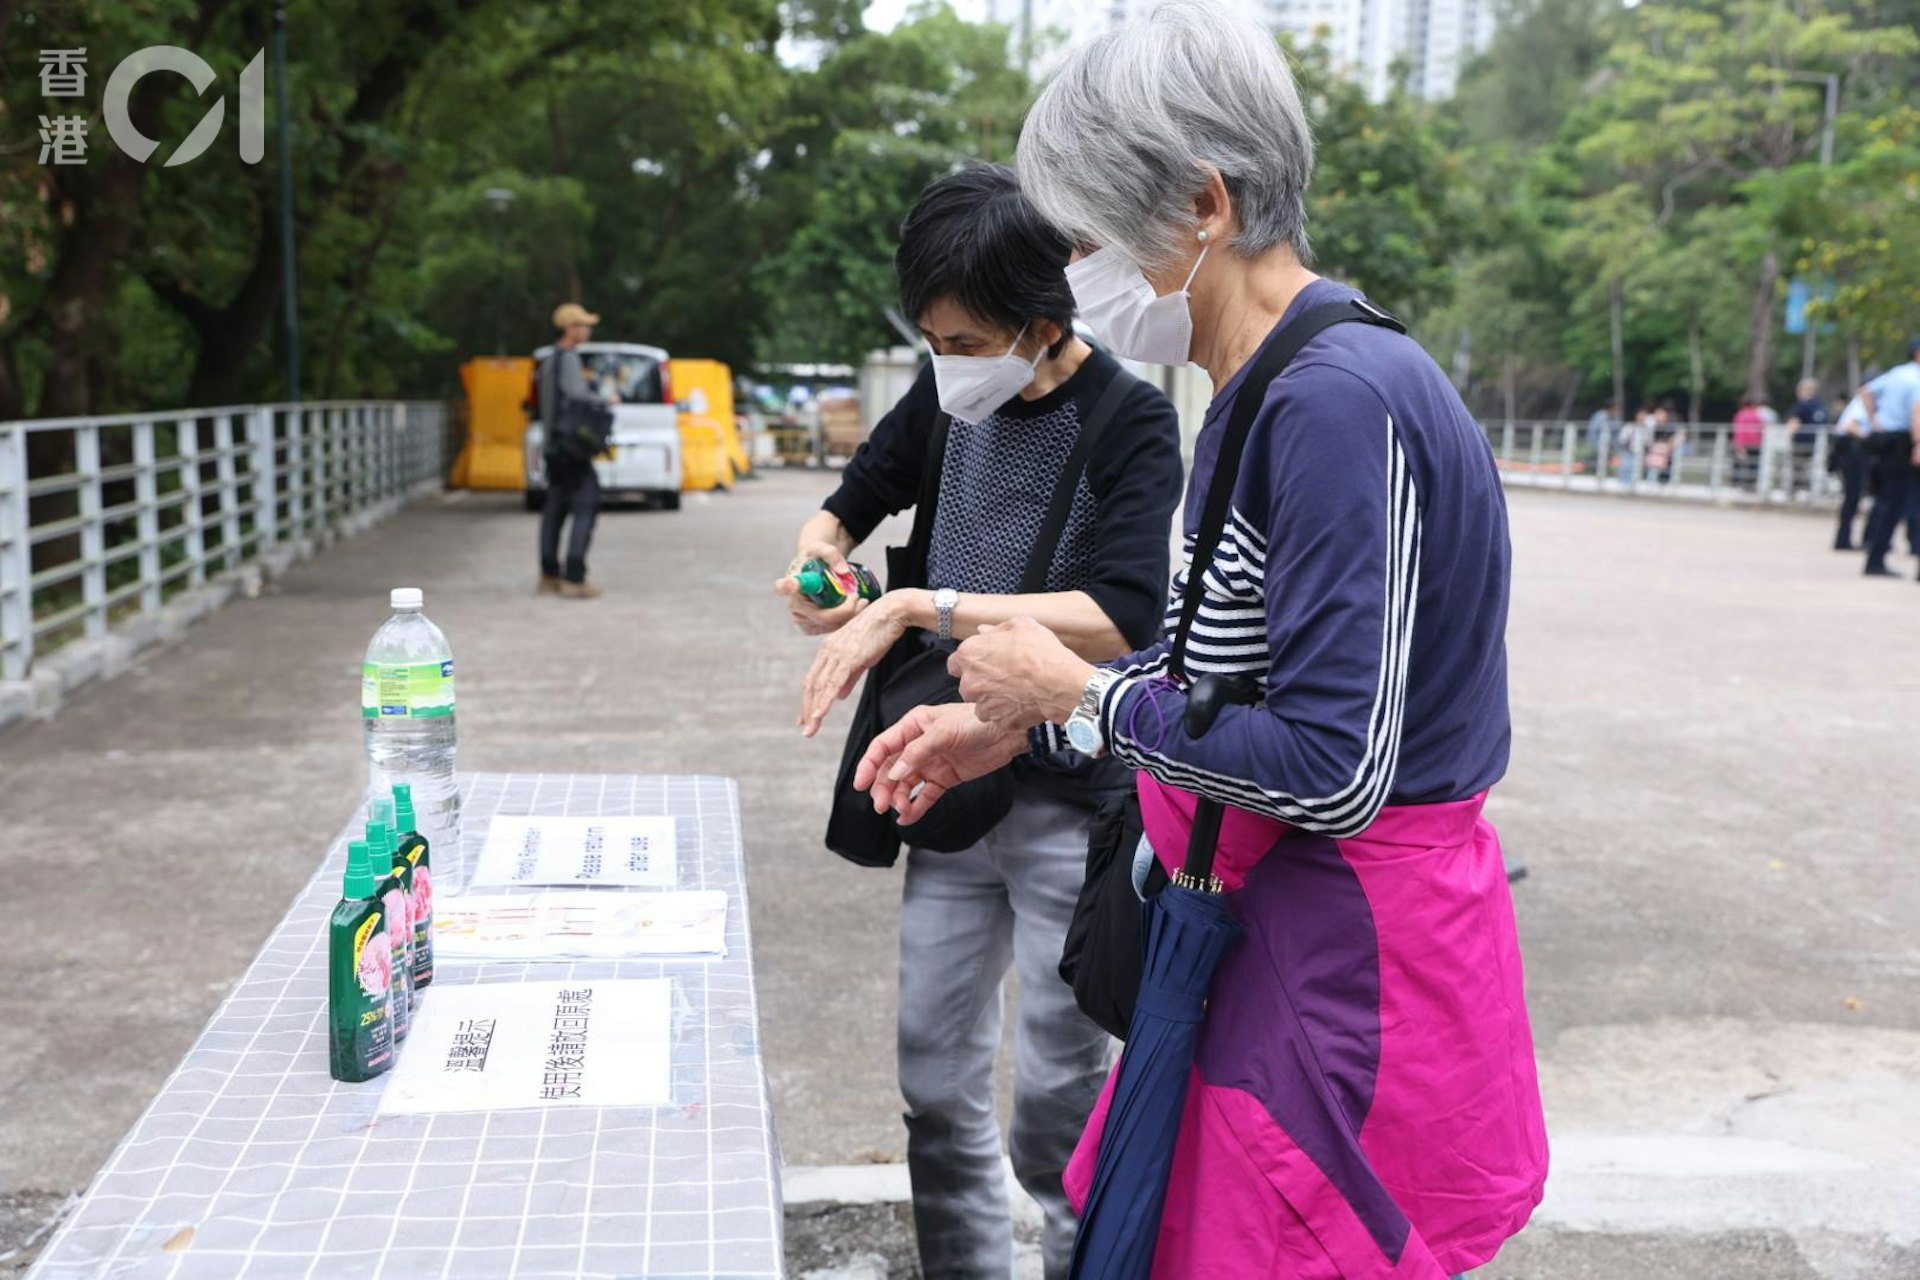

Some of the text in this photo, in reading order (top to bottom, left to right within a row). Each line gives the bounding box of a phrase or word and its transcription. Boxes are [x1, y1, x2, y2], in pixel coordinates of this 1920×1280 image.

[574, 854, 603, 879] Please
[539, 988, 593, 1100] 使用後請放回原處
